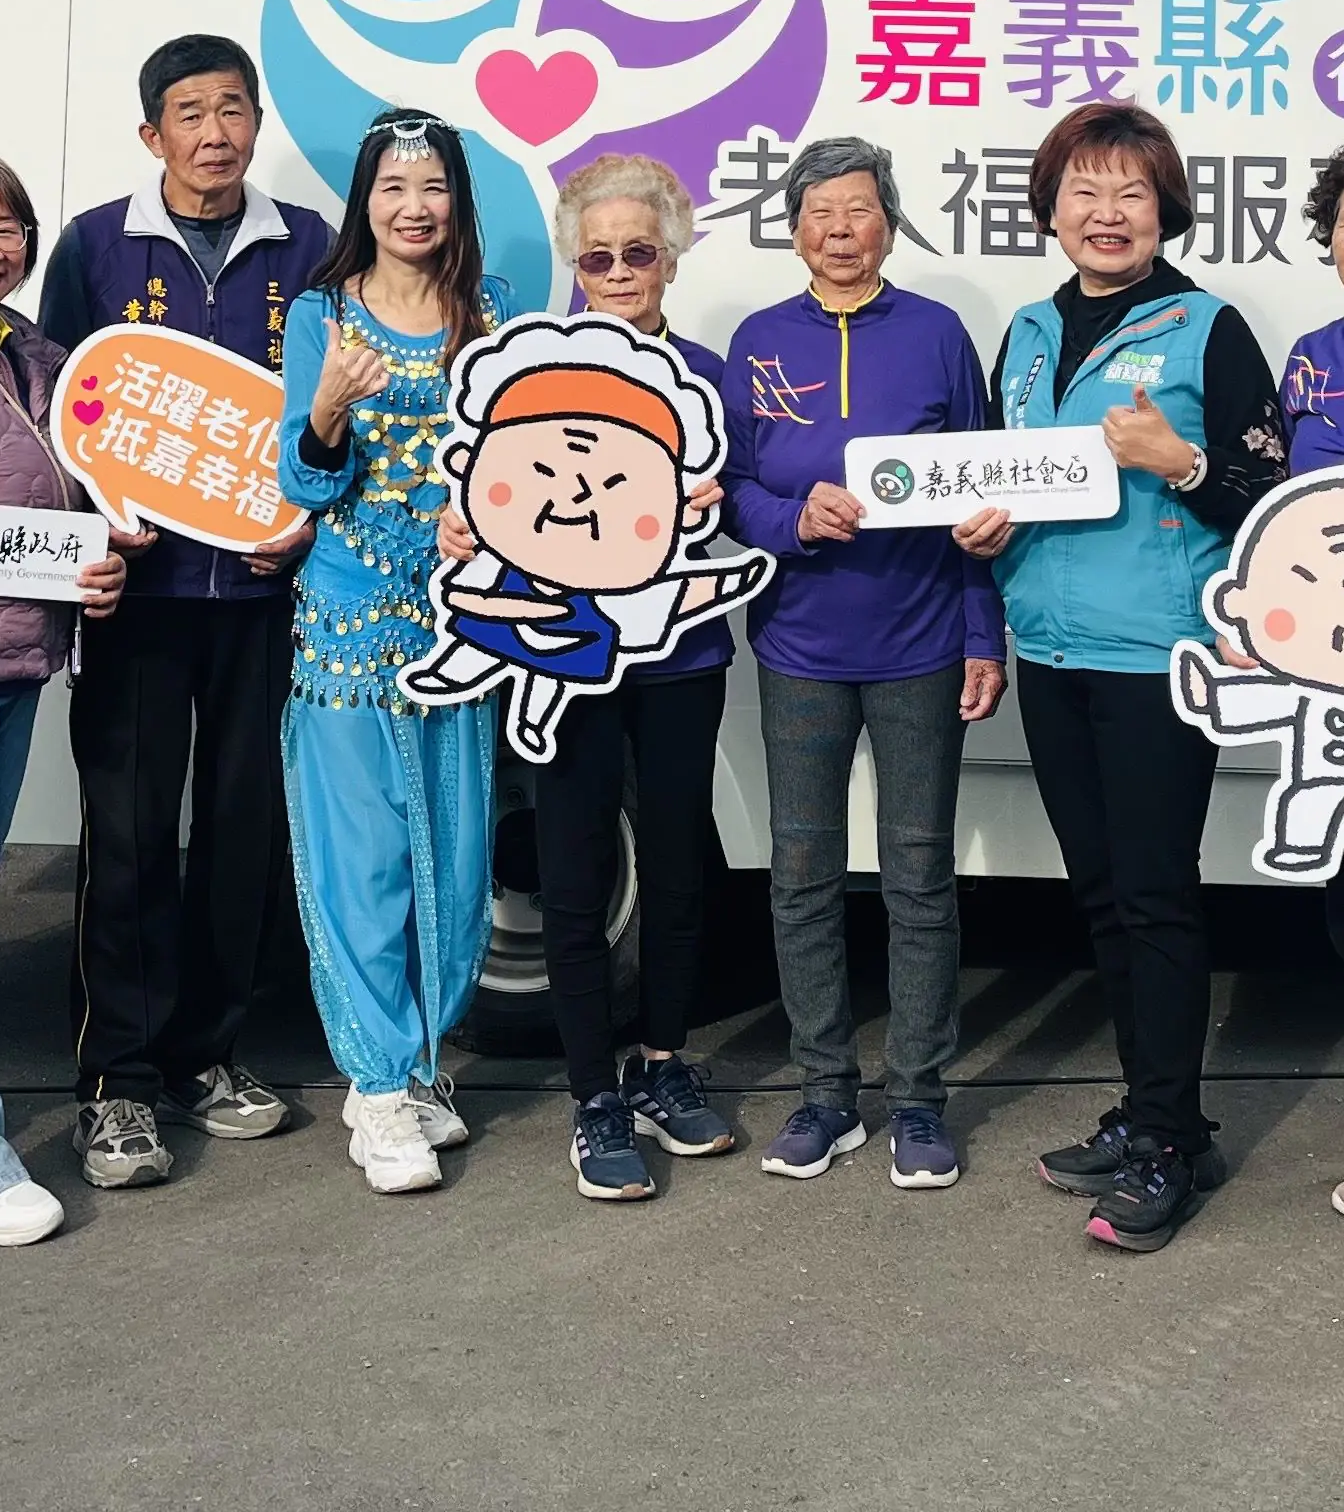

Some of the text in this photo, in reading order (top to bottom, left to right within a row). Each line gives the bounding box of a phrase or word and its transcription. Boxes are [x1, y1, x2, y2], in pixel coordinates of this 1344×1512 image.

[146, 277, 169, 326] 總幹
[104, 352, 281, 471] 活躍老化
[95, 408, 283, 527] 抵嘉幸福
[919, 455, 1088, 500] 嘉義縣社會局
[16, 567, 78, 583] Governmen
